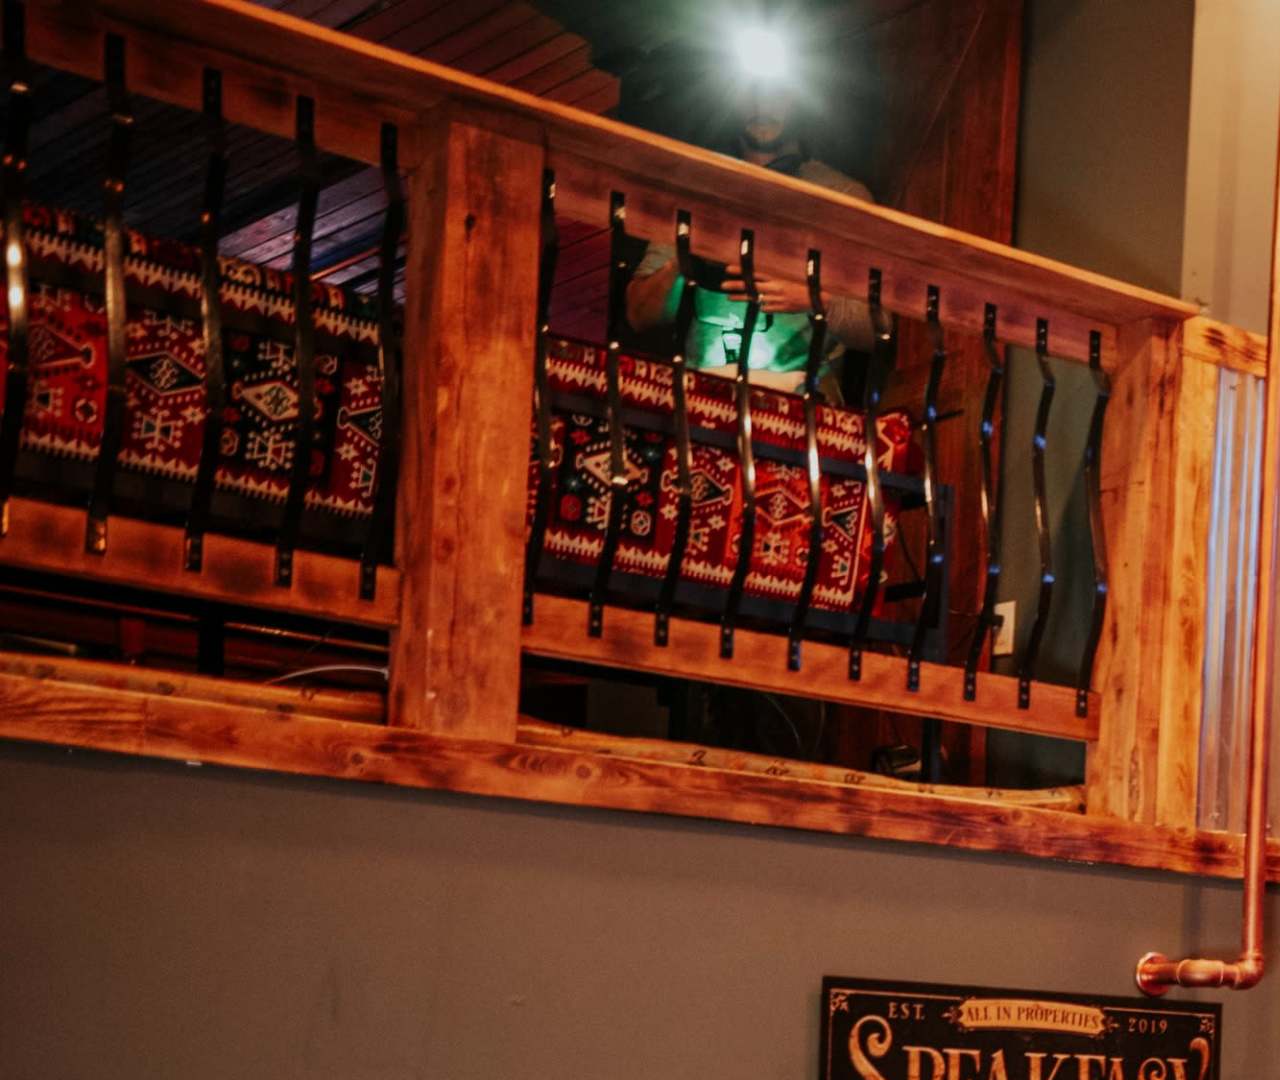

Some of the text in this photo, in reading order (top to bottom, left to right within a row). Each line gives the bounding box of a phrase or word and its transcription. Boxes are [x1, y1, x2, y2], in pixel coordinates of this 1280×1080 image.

[966, 1005, 1100, 1029] ALL IN PROPERTIES
[1127, 1017, 1168, 1034] 2019
